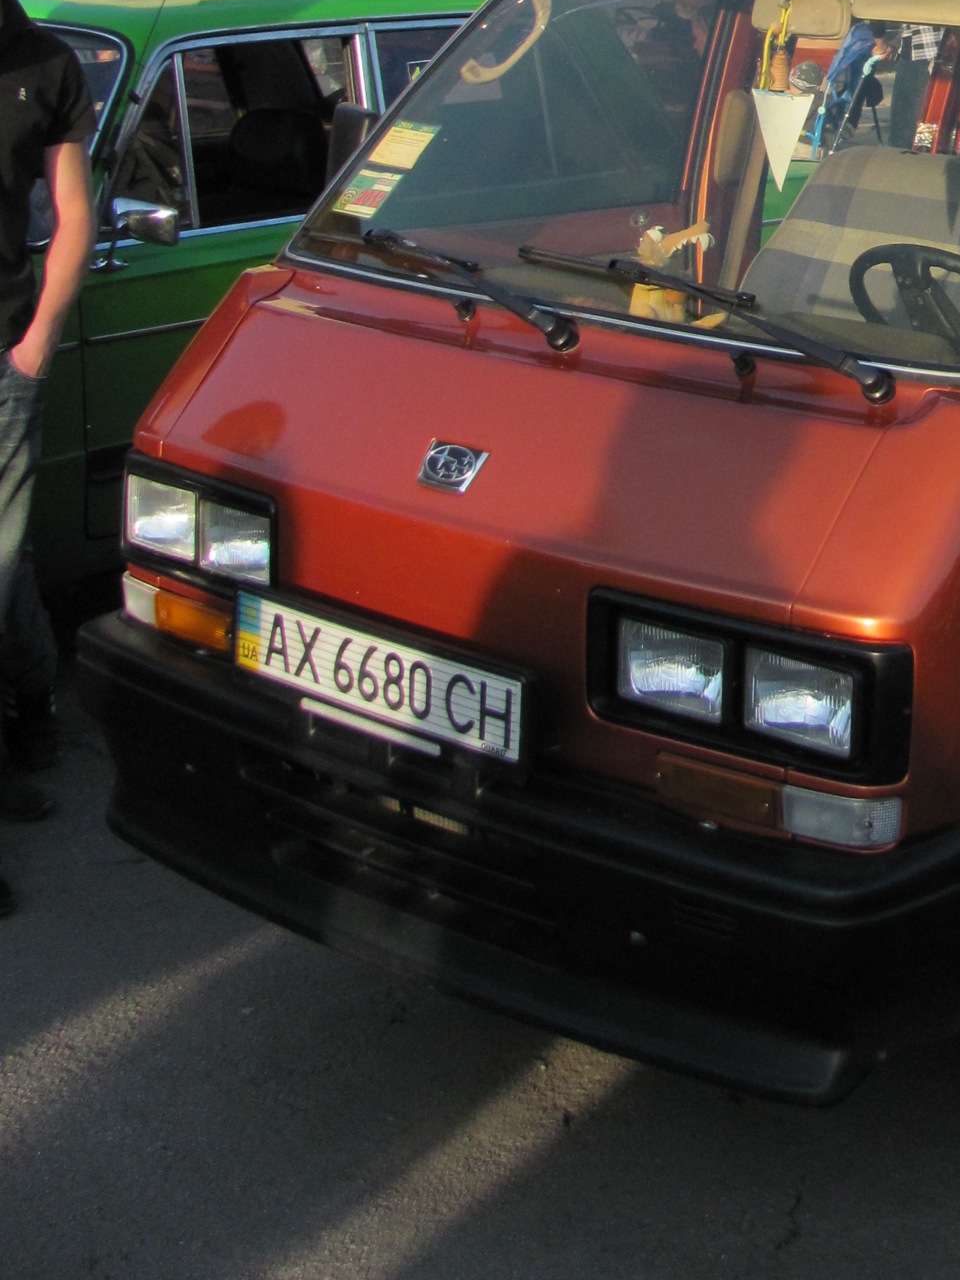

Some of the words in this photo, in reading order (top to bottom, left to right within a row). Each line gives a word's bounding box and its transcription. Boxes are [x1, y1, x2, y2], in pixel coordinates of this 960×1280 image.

[352, 189, 387, 209] 2012
[242, 641, 259, 662] UA
[265, 613, 321, 685] AX
[333, 637, 433, 721] 6680
[445, 673, 512, 749] CH
